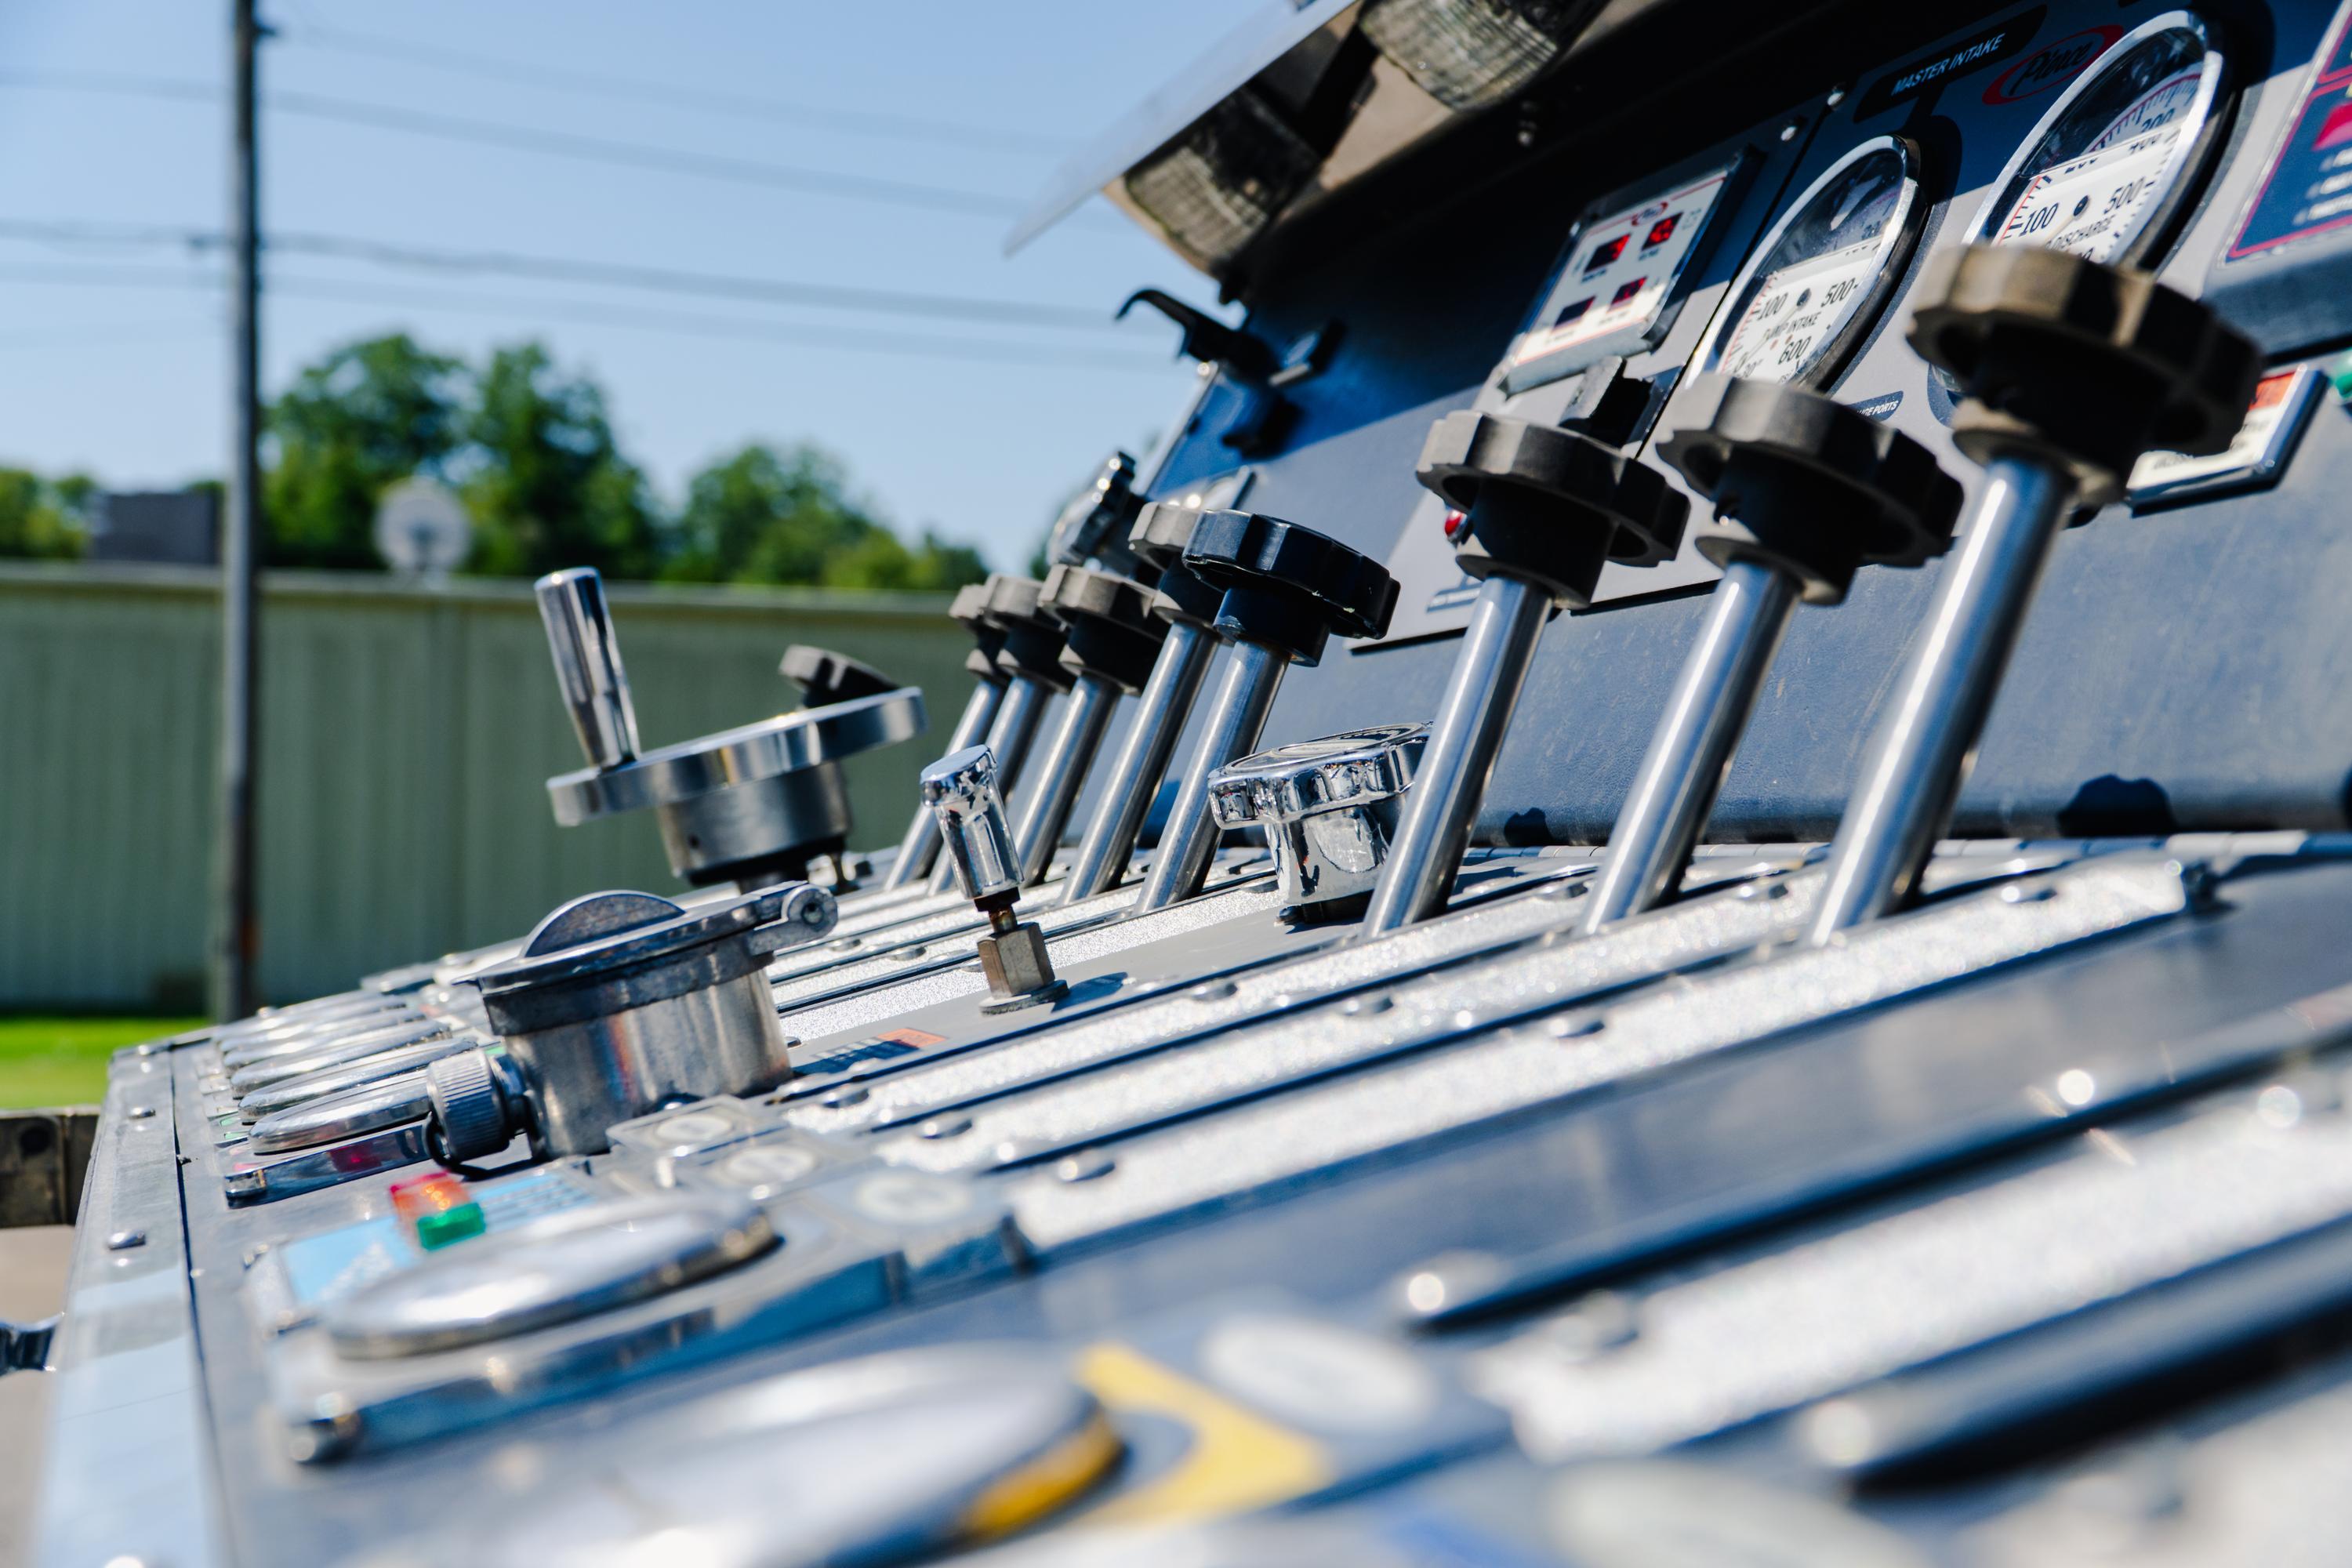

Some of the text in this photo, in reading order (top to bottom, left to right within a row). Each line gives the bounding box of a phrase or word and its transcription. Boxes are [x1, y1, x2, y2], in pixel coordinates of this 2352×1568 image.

[1890, 33, 2006, 96] MASTER INTAKE
[2103, 176, 2146, 215] 500
[2019, 202, 2060, 237] 100
[1757, 292, 1788, 321] 100
[1820, 277, 1856, 308] 500
[1787, 310, 1822, 334] INTAKE
[1777, 335, 1812, 365] 600
[1871, 400, 1899, 416] PORTS
